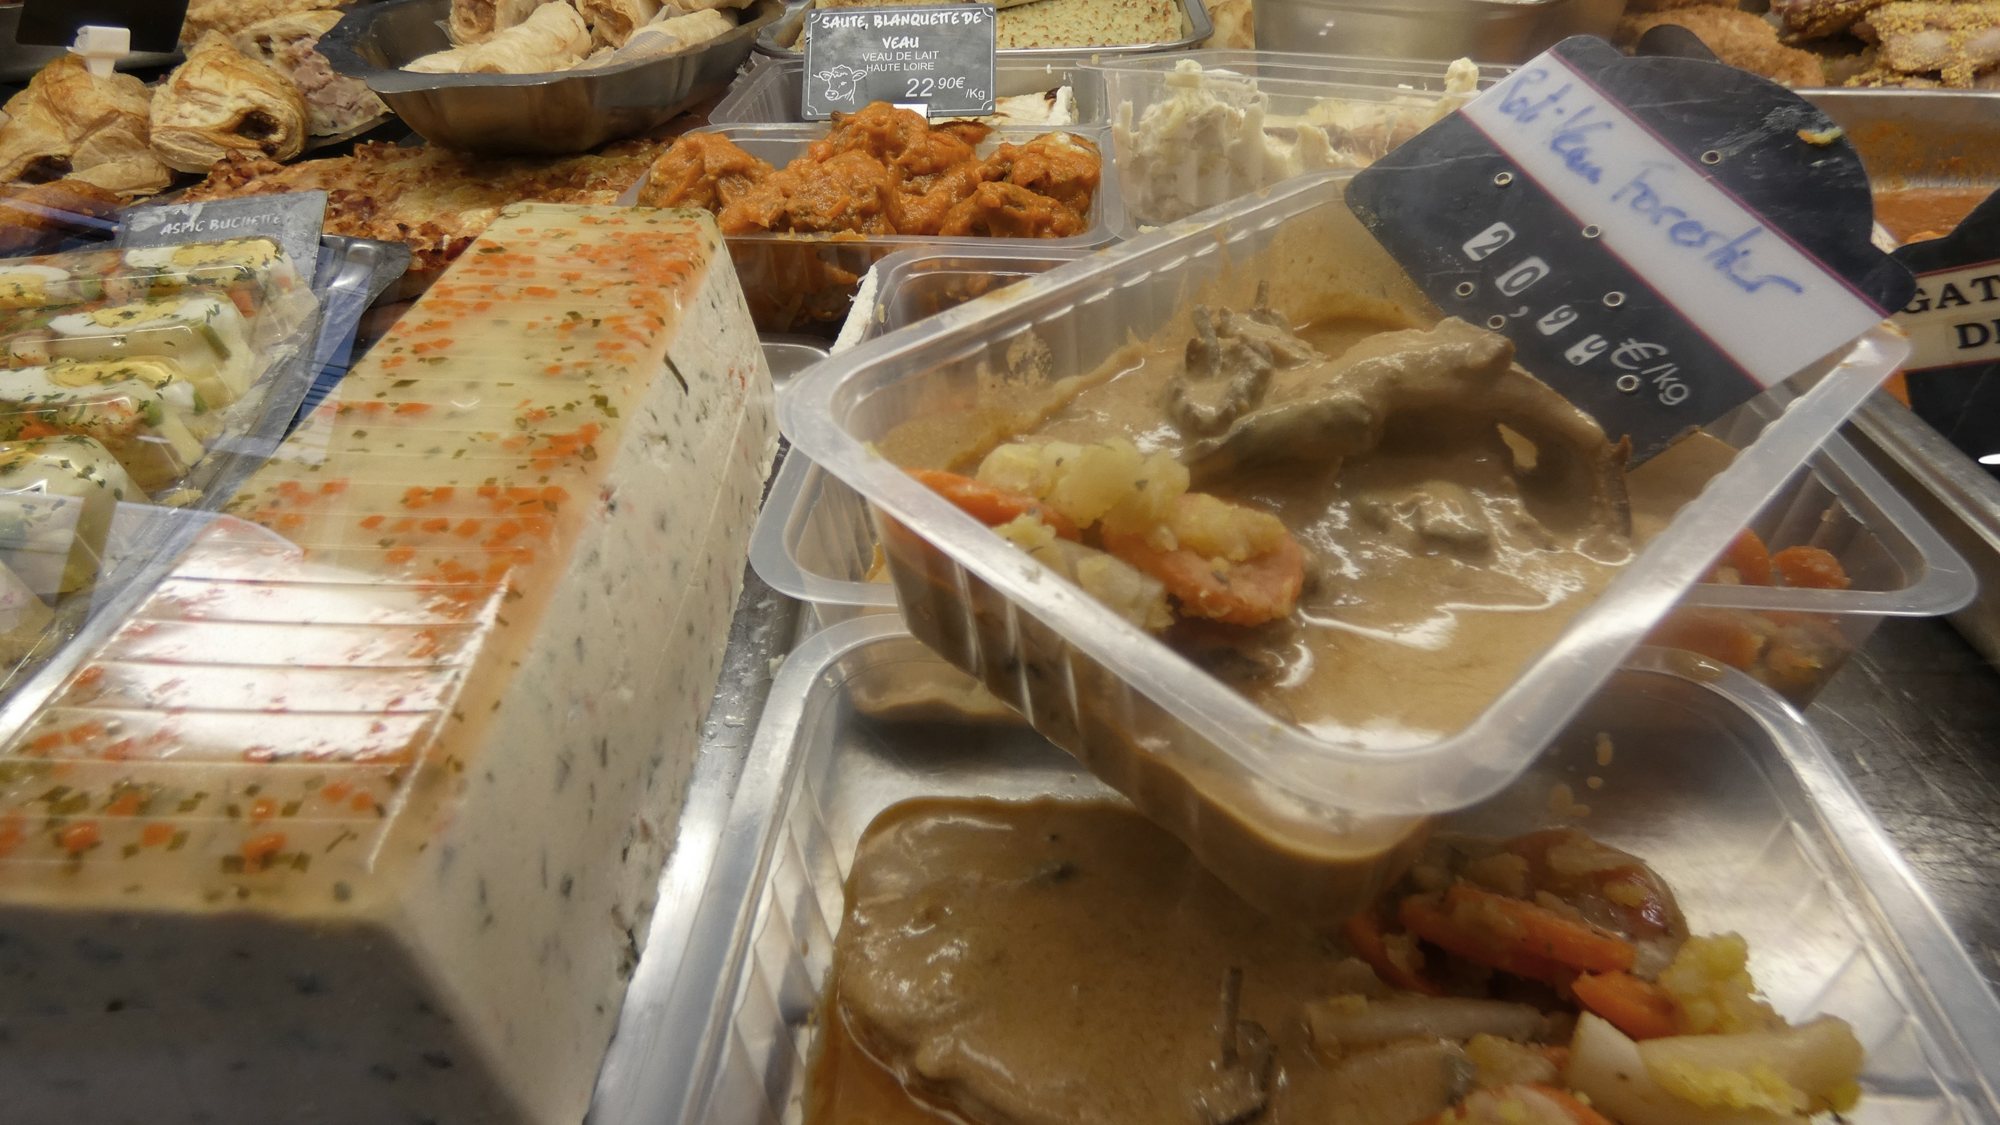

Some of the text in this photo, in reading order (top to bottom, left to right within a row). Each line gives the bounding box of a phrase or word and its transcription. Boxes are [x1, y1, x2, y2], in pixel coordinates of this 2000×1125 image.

[873, 12, 960, 29] BLANQUETTE
[961, 11, 982, 25] DE
[882, 36, 919, 49] VEAU
[862, 50, 939, 62] VEAU DE LAIT
[866, 62, 935, 72] HAUTE LOIRE
[160, 220, 205, 236] ASPIC
